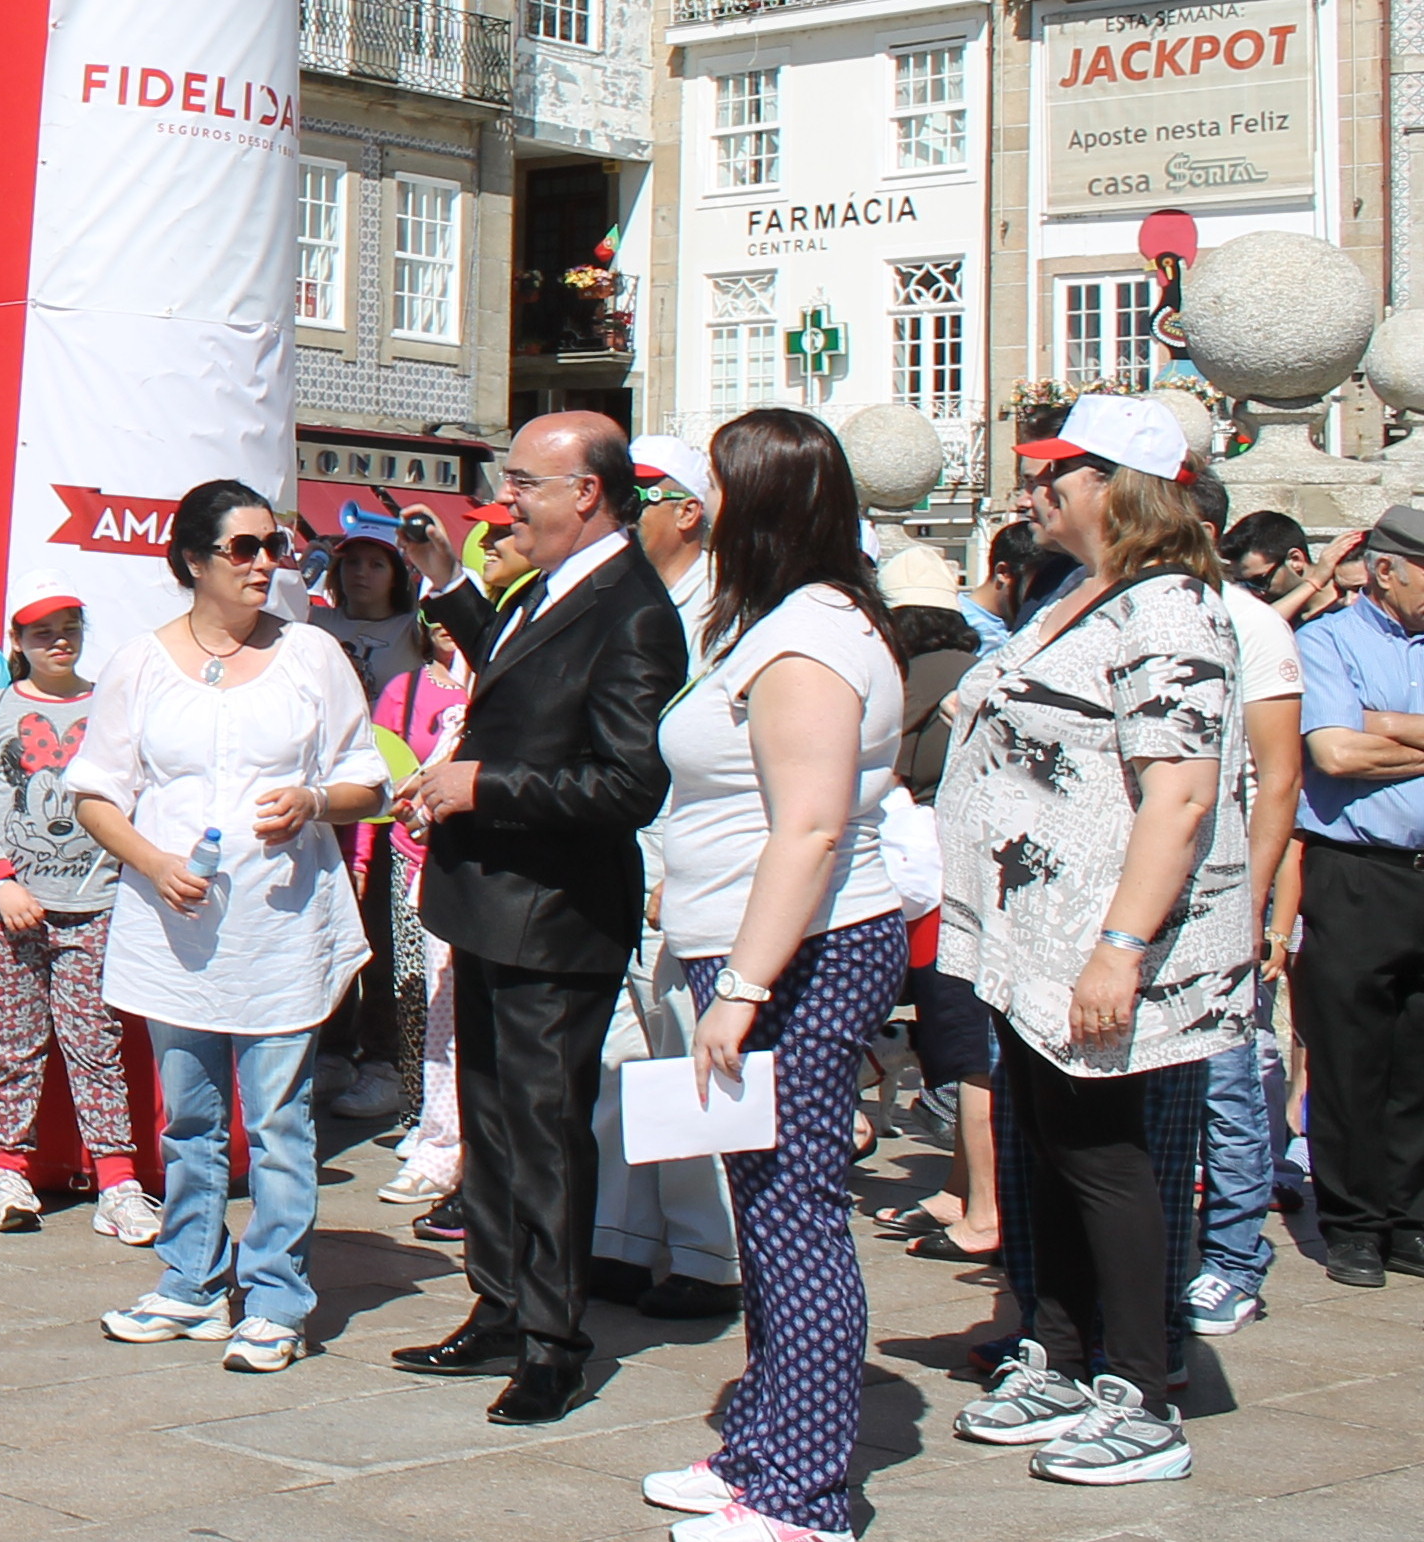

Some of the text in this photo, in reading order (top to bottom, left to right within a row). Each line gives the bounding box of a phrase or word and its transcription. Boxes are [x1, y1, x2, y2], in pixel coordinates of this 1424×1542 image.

[1105, 3, 1245, 33] ESTA SEMANA:
[1059, 24, 1297, 88] JACKPOT
[82, 64, 299, 138] FIDELIDA
[157, 122, 232, 142] SEGUROS
[238, 133, 274, 151] DESDE
[1068, 110, 1290, 152] Aposte nesta Feliz
[1088, 174, 1151, 196] casa
[748, 191, 917, 236] FARMÁCIA
[747, 238, 828, 256] CENTRAL
[8, 849, 94, 885] Minni
